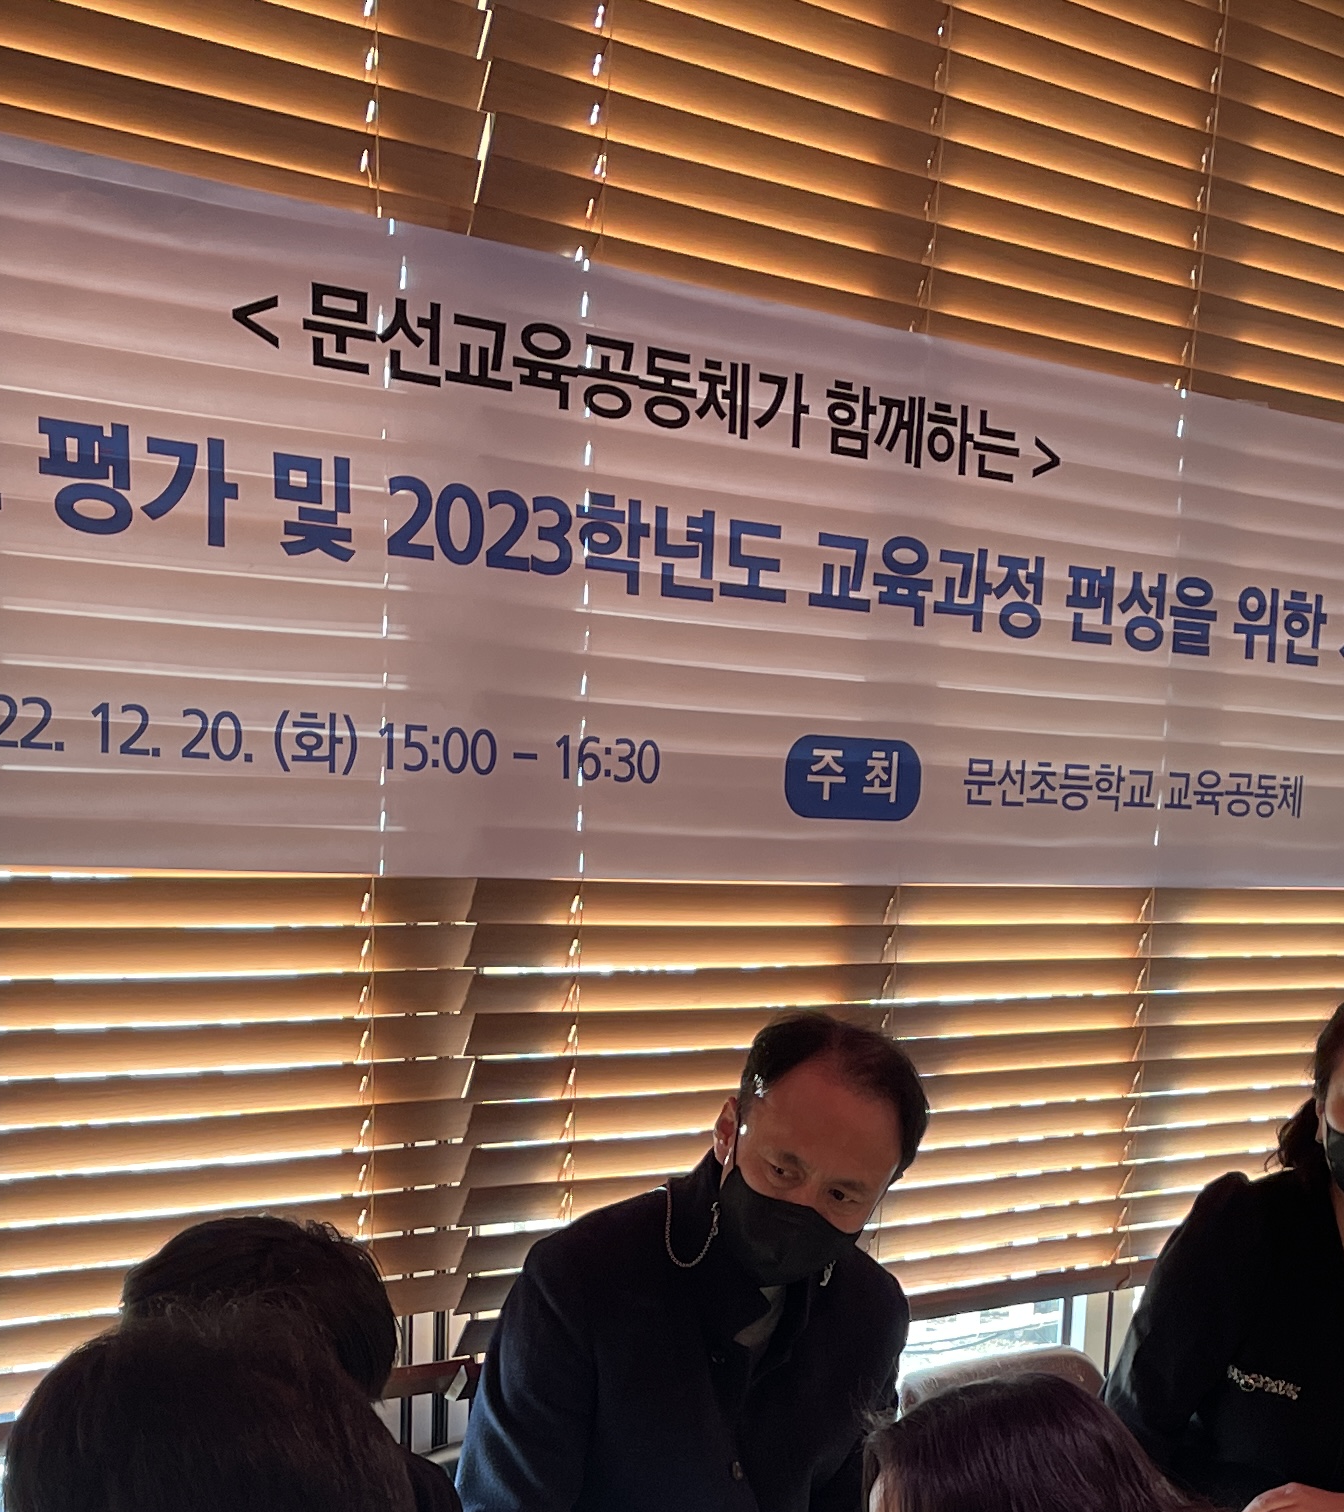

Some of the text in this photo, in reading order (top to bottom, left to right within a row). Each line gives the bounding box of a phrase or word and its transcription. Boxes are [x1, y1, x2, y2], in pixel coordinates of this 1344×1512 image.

[303, 283, 809, 448] 문선교육공동체가
[827, 380, 1019, 482] 함께하는
[39, 417, 238, 547] 평가
[274, 453, 355, 562] 및
[388, 476, 786, 603] 2023학년도
[809, 533, 1044, 638] 교육과정
[1066, 566, 1217, 656] 편성을
[1234, 587, 1327, 666] 위한
[275, 711, 357, 775] (화)
[380, 723, 497, 775] 15:00
[556, 736, 660, 784] 16:30
[964, 759, 1302, 818] 문선초등학교 교육공동체
